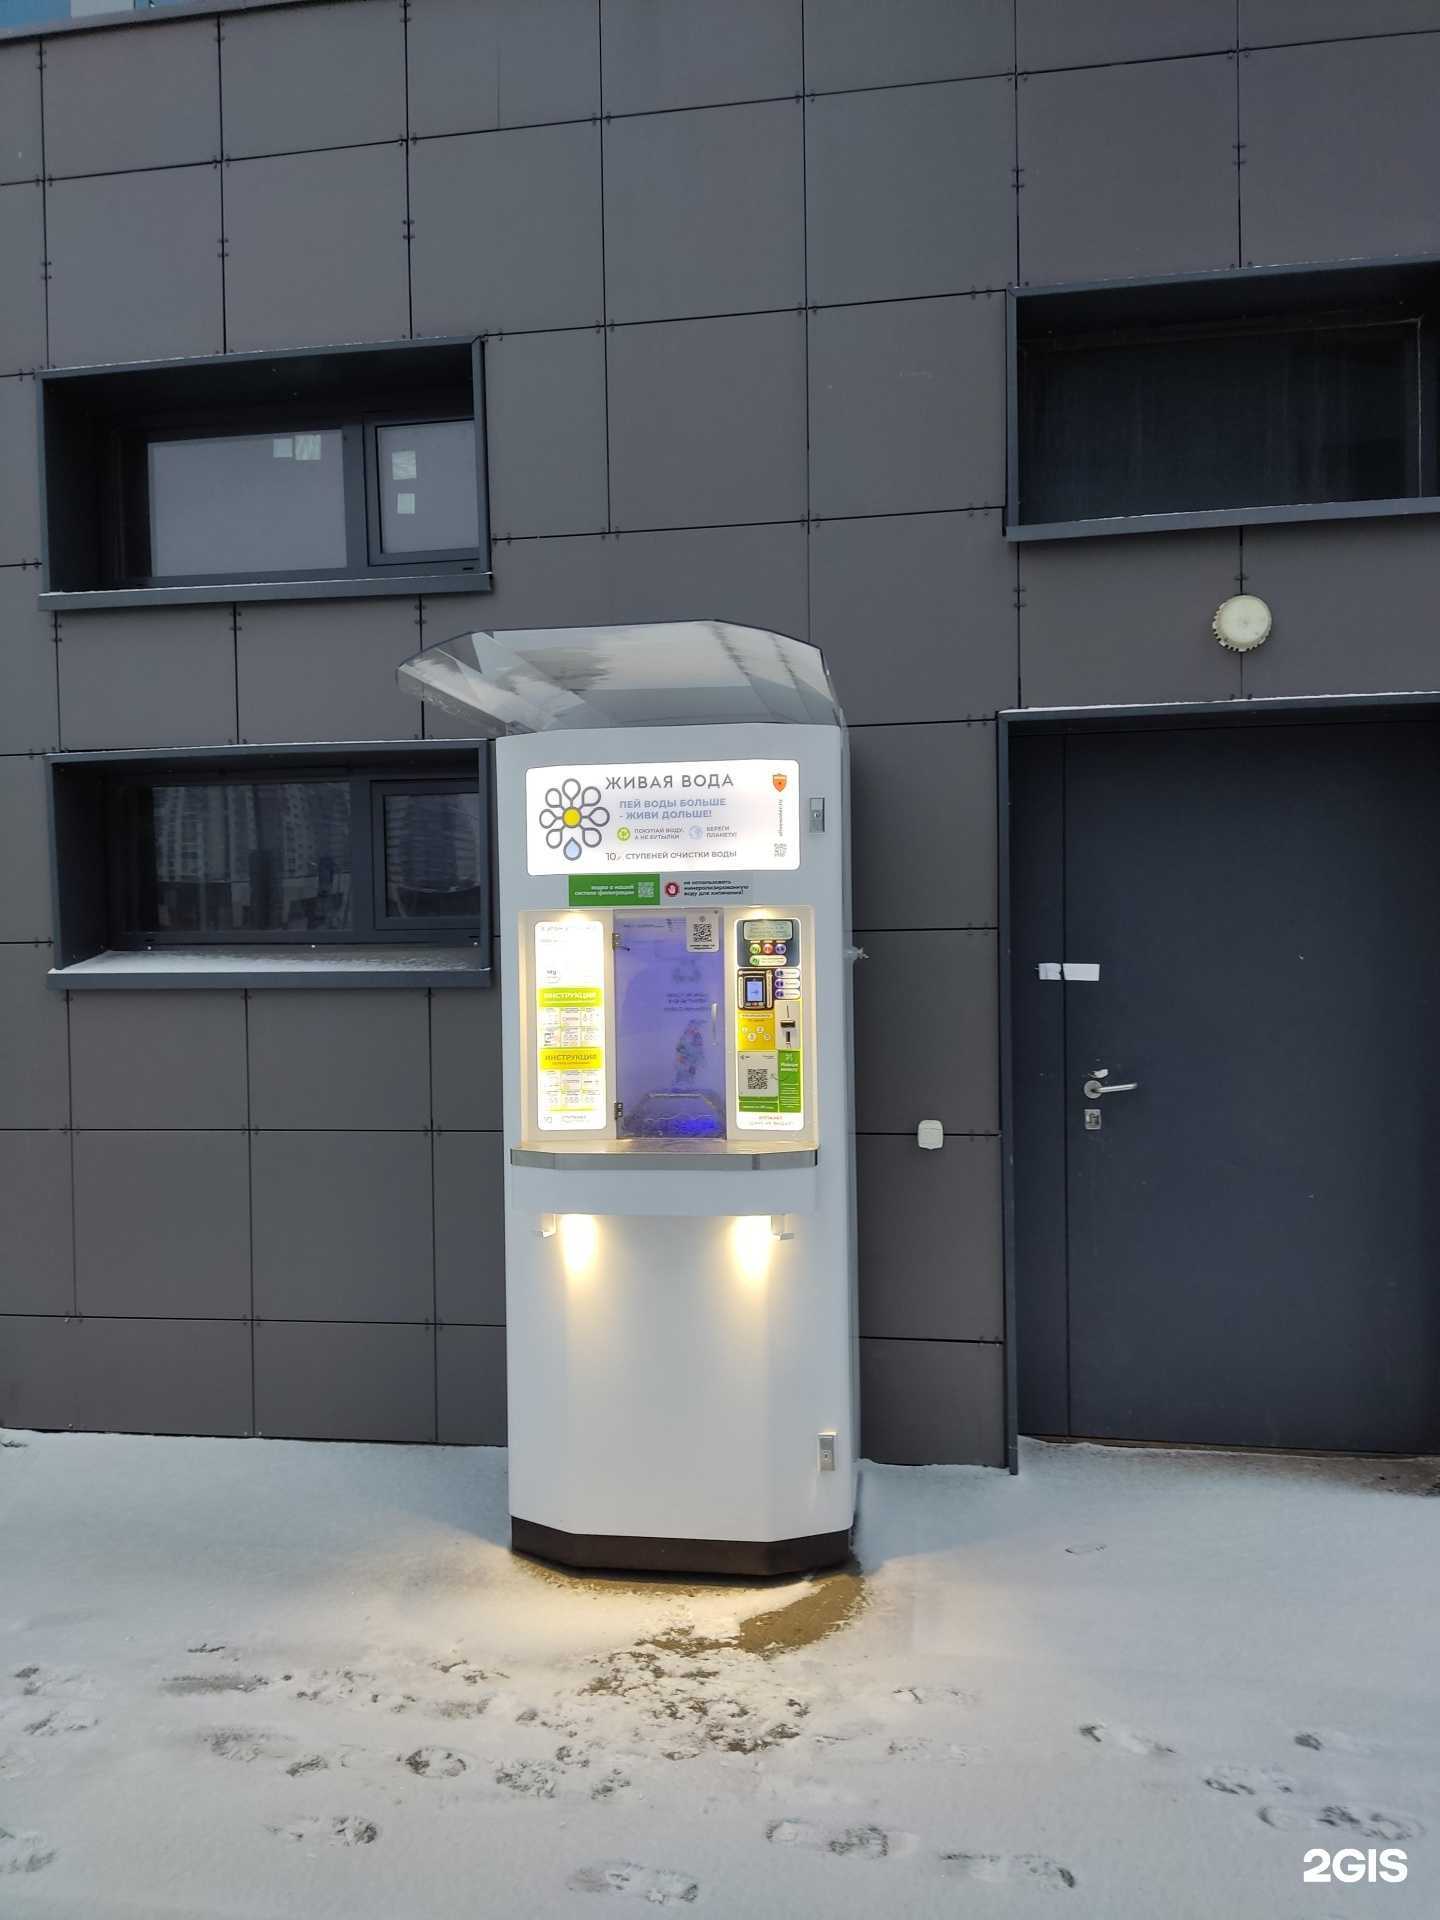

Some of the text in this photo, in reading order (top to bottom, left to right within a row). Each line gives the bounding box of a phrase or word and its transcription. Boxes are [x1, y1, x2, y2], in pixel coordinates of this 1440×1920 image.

[605, 773, 734, 790] ЖИВАЯ ВОДА
[619, 798, 727, 809] ПЕЙ ВОДЫ БОЛЬШЕ
[626, 811, 659, 820] ЖИВИ
[661, 810, 712, 820] ДОЛЬШЕ!
[625, 851, 669, 860] СТУПЕНЕЙ
[670, 850, 710, 859] ОЧИСТКИ
[711, 850, 737, 858] ВОДЫ
